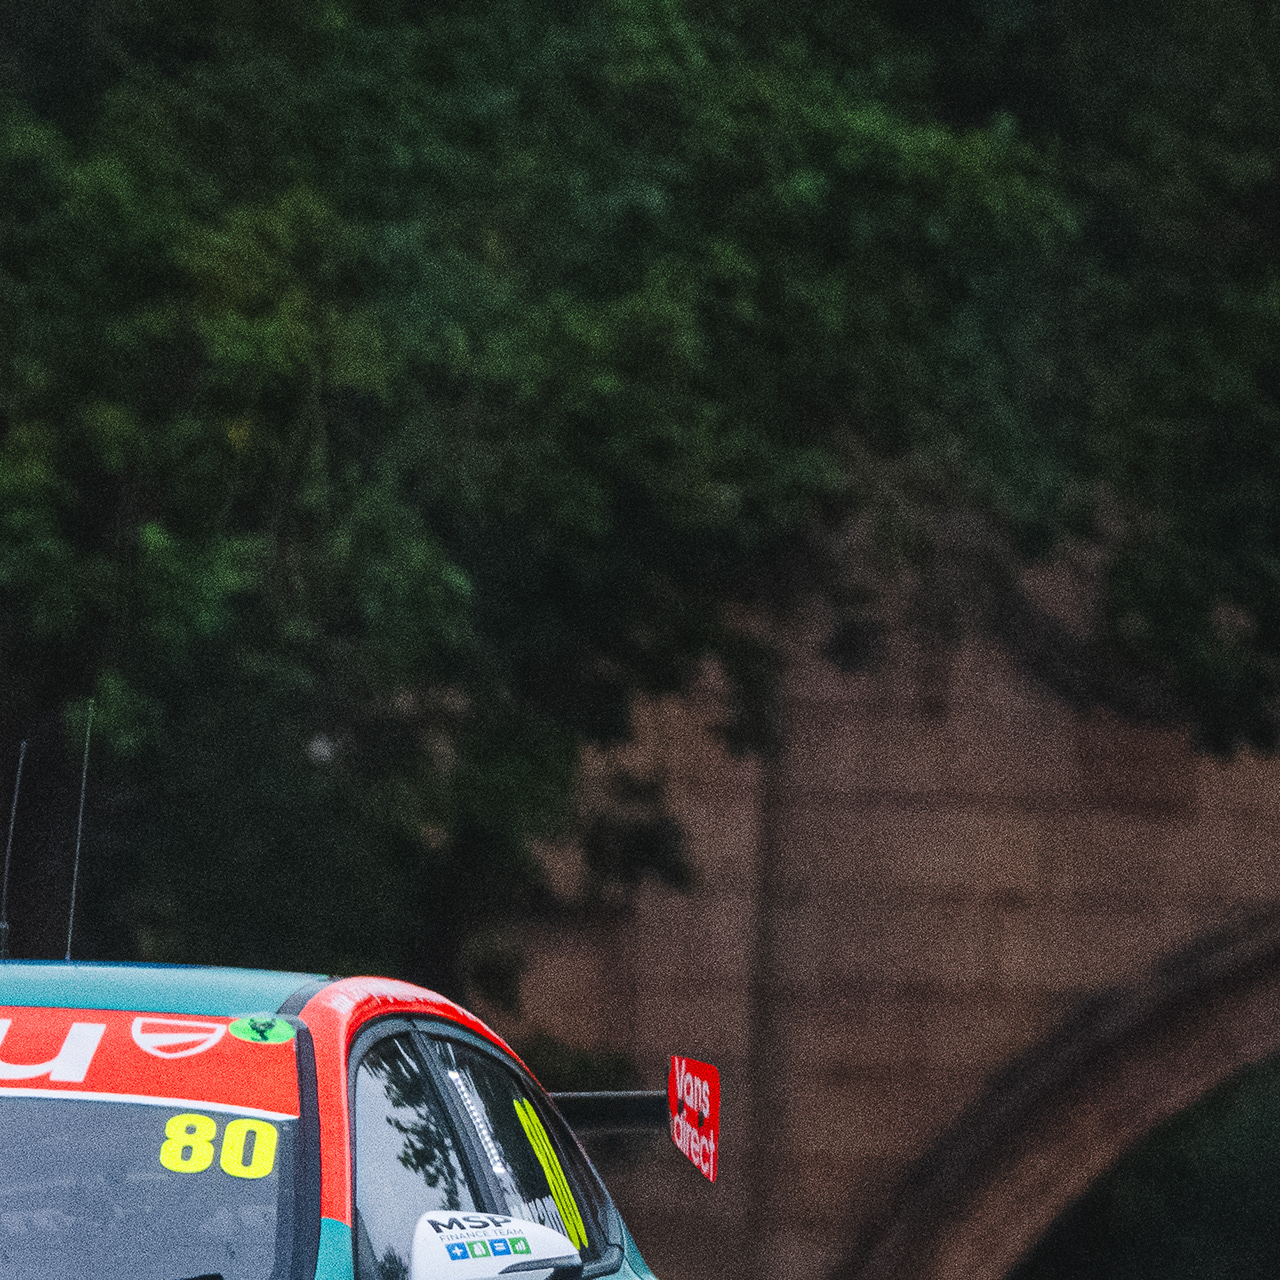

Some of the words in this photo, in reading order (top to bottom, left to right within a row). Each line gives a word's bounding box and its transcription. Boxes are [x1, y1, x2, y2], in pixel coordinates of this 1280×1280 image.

[675, 1057, 710, 1118] Vans
[159, 1113, 278, 1179] 80
[427, 1215, 512, 1234] MSP
[439, 1230, 491, 1242] FINANCE
[493, 1228, 524, 1237] TEAM
